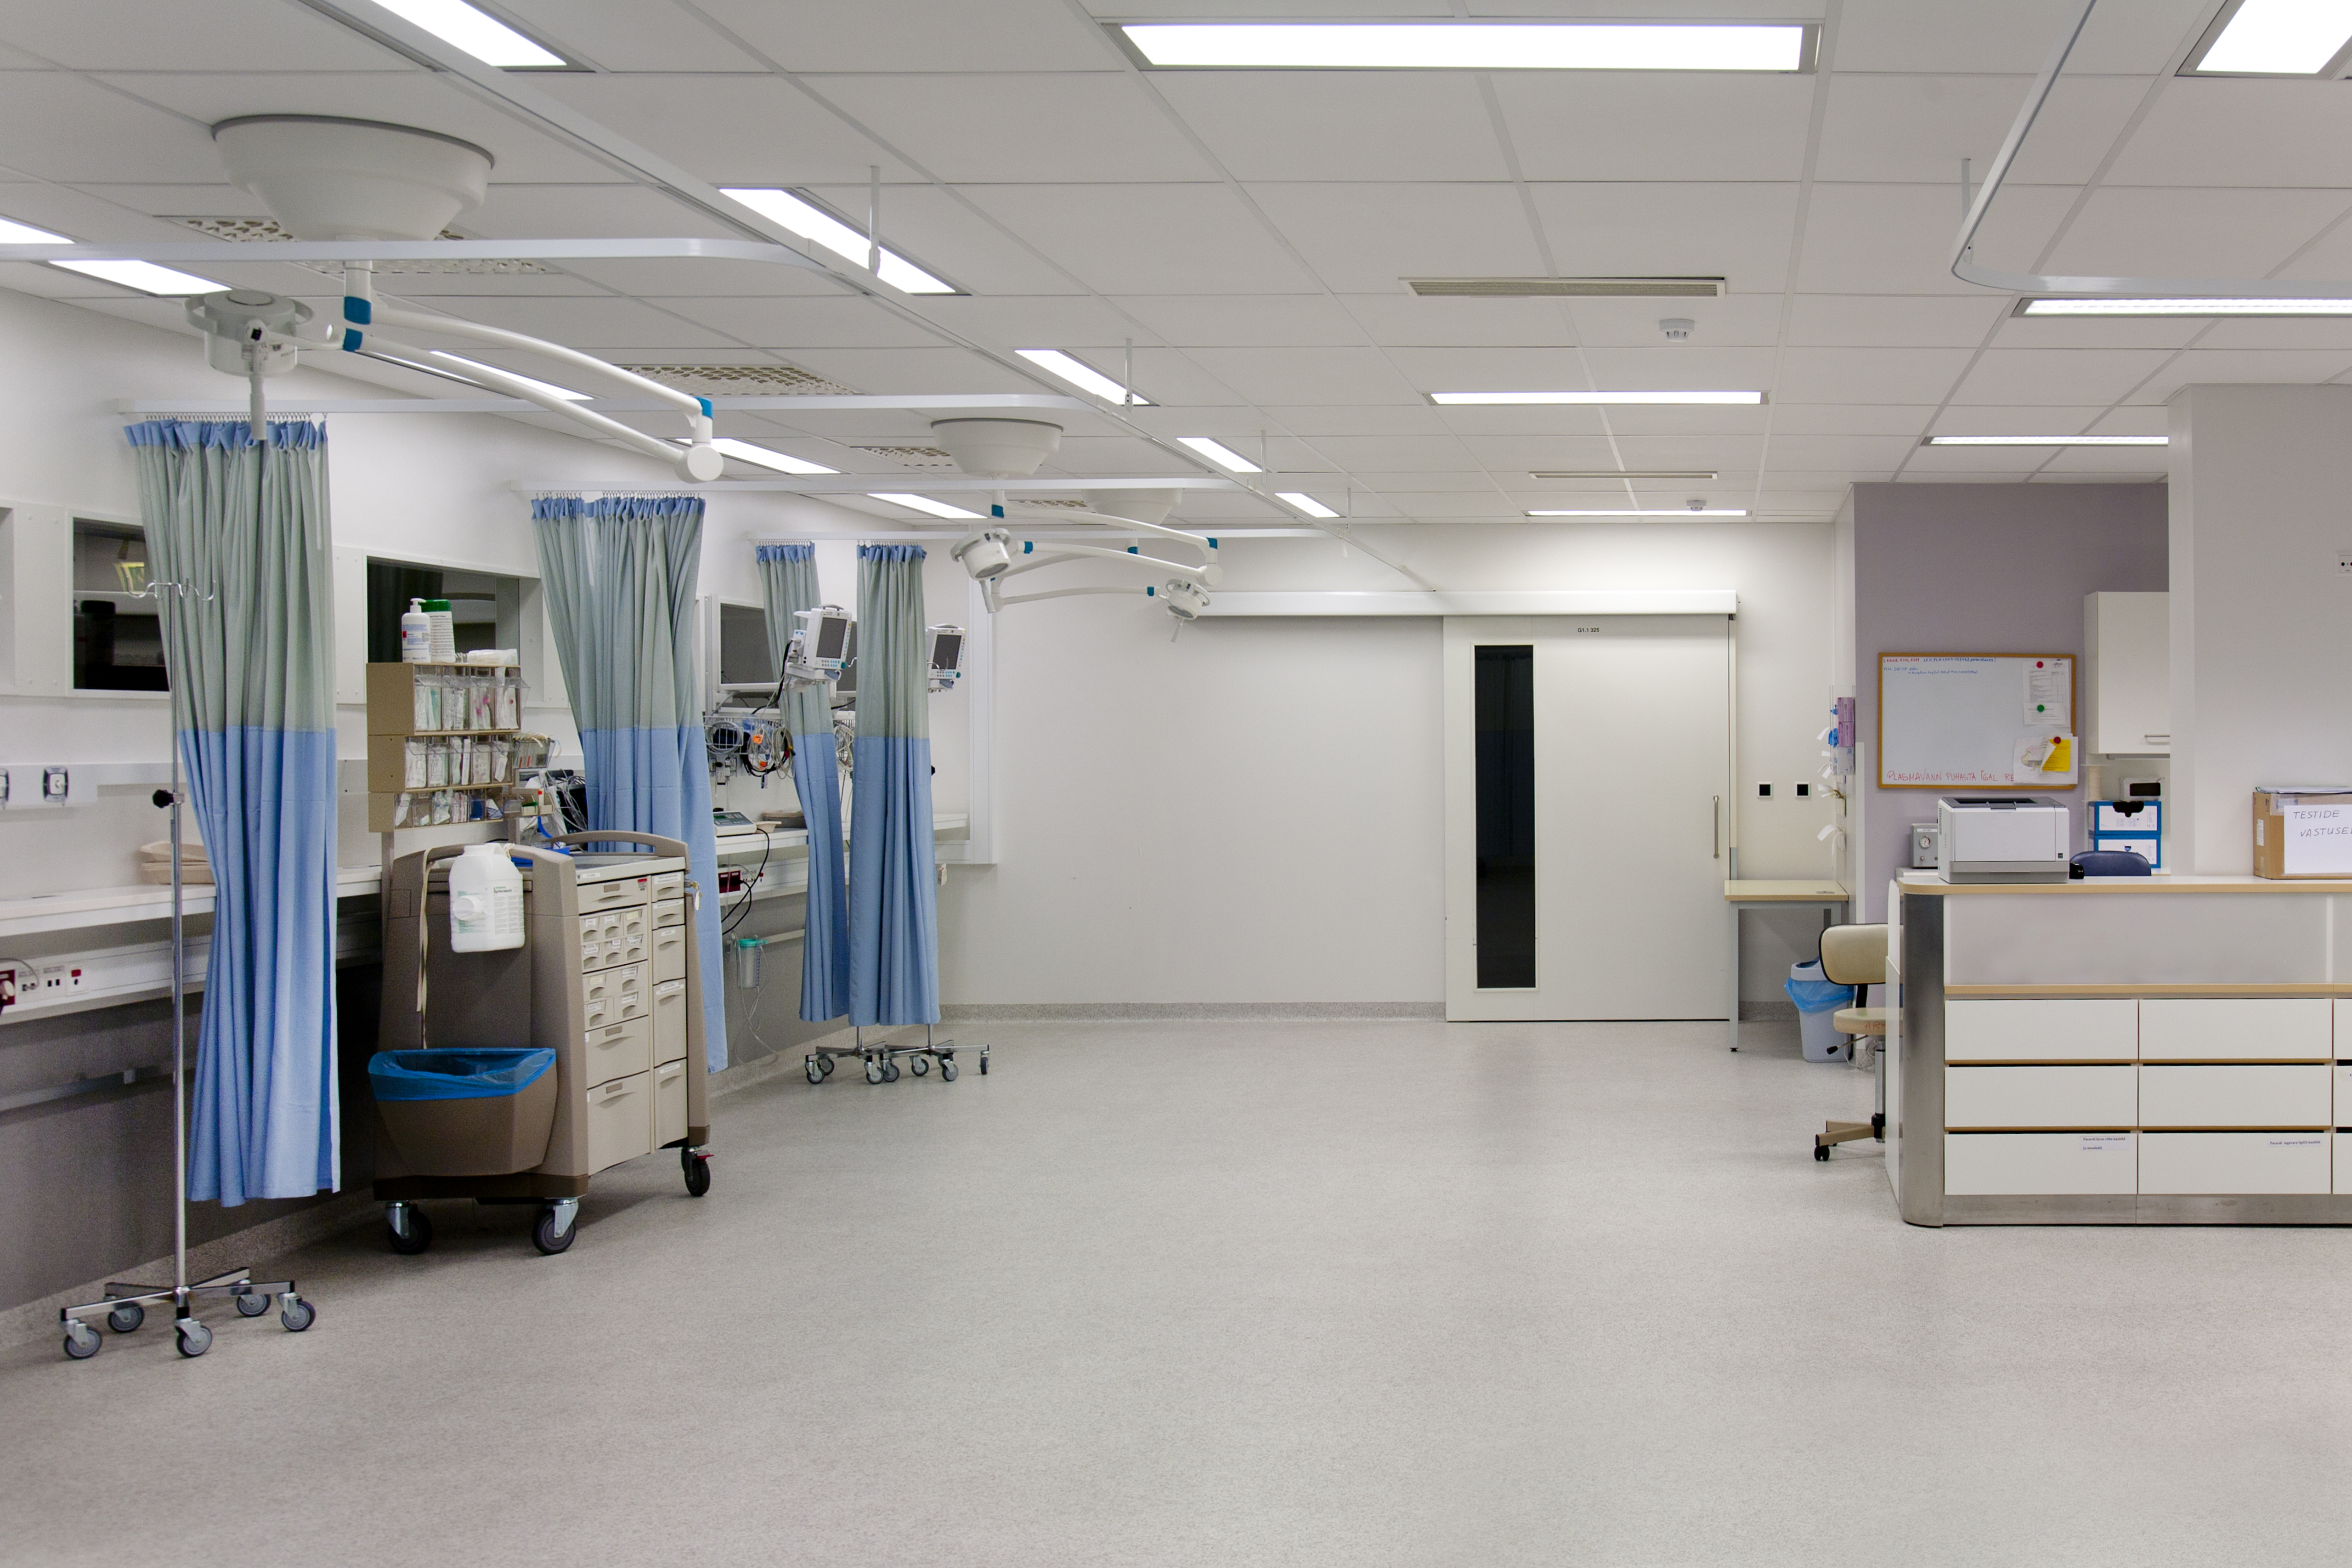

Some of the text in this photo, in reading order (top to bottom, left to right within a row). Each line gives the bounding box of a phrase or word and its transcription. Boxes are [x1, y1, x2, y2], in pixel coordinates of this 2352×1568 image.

[1945, 772, 1976, 781] PUHASTA
[2293, 810, 2340, 819] TESTIDE
[2301, 827, 2352, 837] VASTUSE
